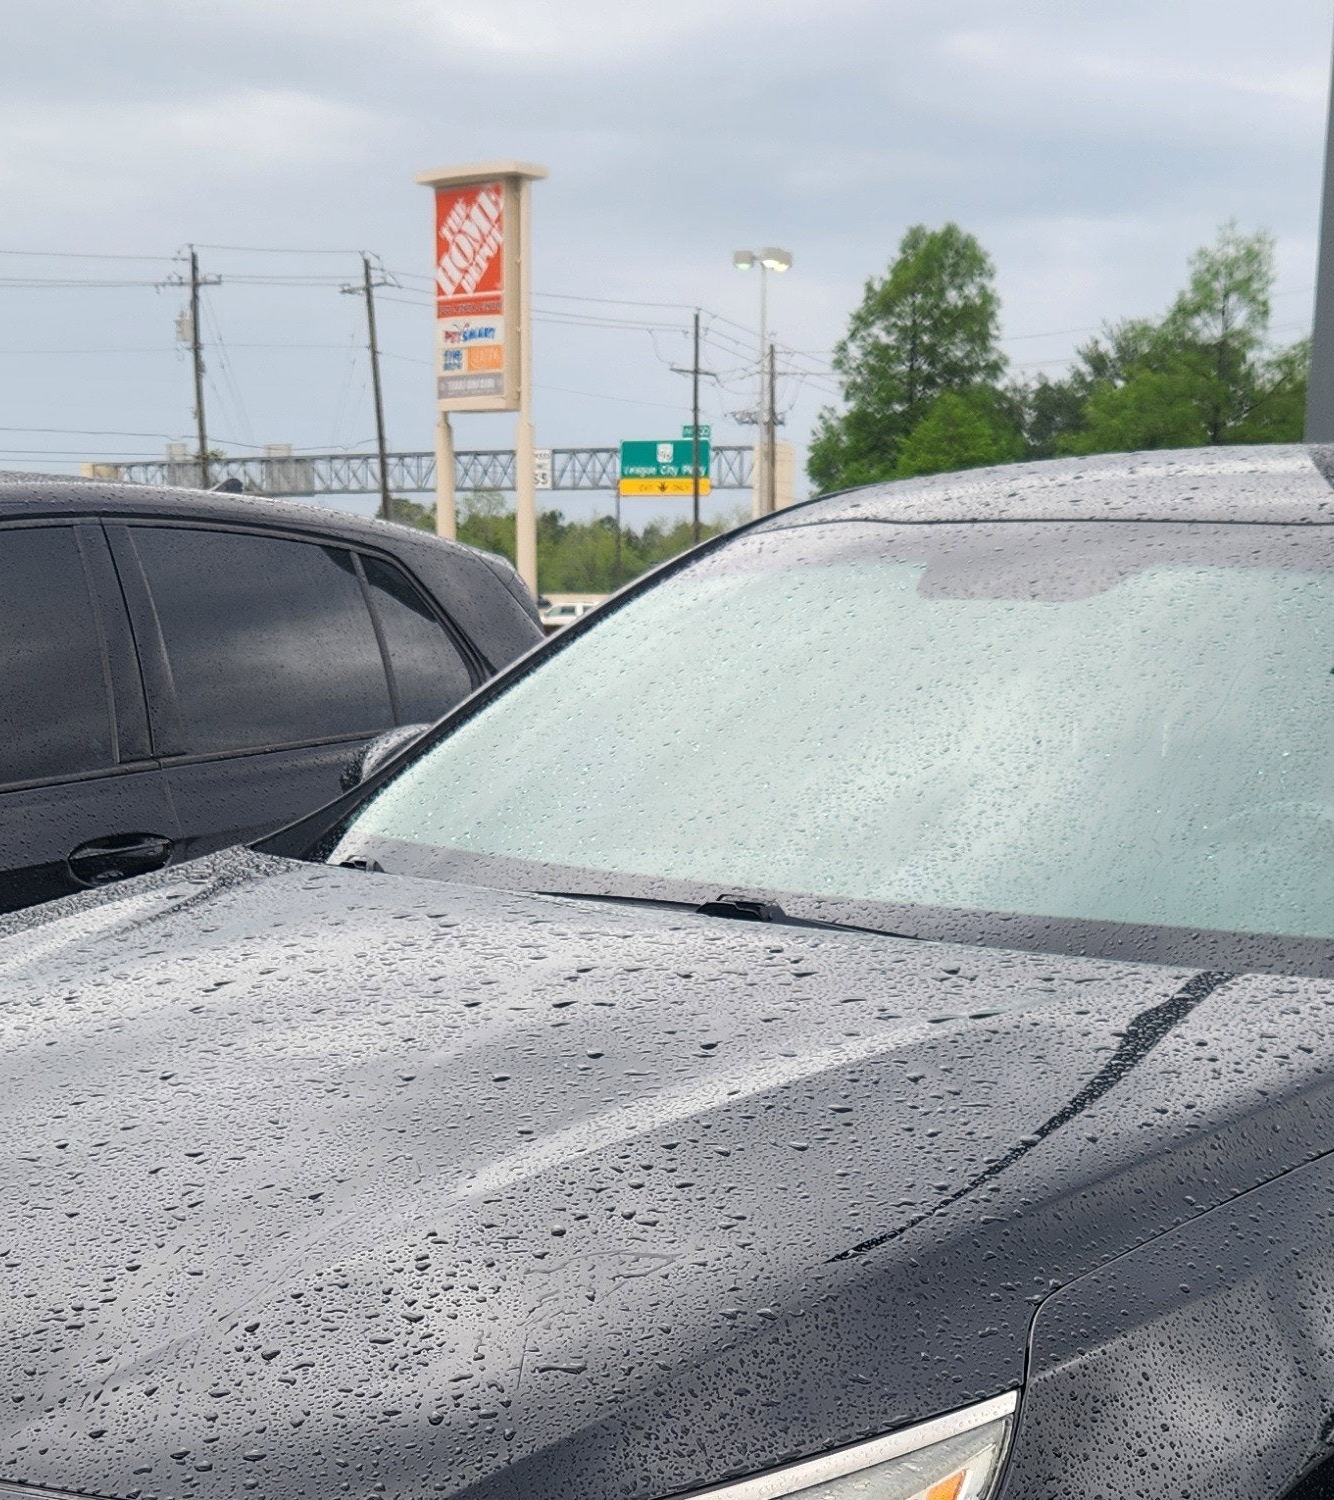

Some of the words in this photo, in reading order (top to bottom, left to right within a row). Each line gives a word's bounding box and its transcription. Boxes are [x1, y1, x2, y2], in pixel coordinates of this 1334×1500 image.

[435, 184, 504, 297] HOME
[440, 197, 467, 242] THE
[460, 223, 504, 296] DEPOT
[659, 464, 679, 477] City
